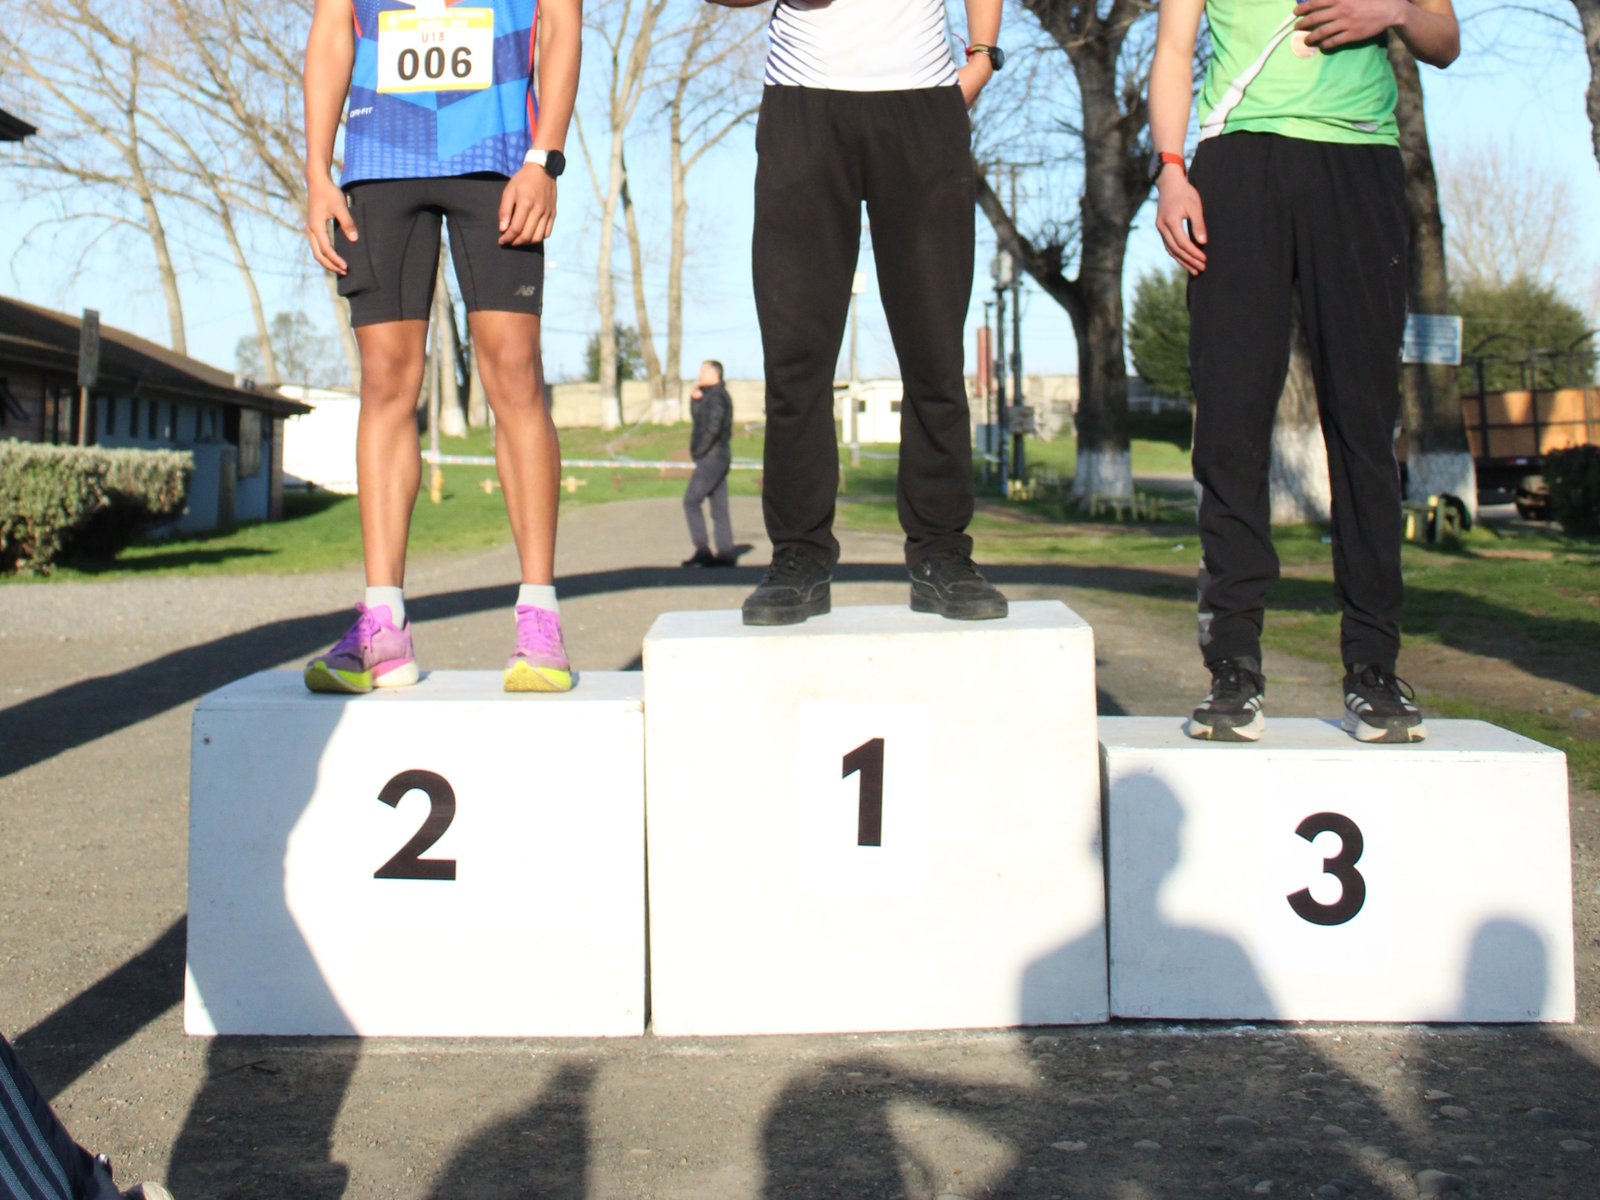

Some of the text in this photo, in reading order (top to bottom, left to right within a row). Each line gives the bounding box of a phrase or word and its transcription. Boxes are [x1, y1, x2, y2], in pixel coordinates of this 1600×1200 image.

[397, 46, 473, 81] 006
[373, 769, 457, 881] 2
[842, 738, 884, 847] 1
[1286, 812, 1366, 926] 3
